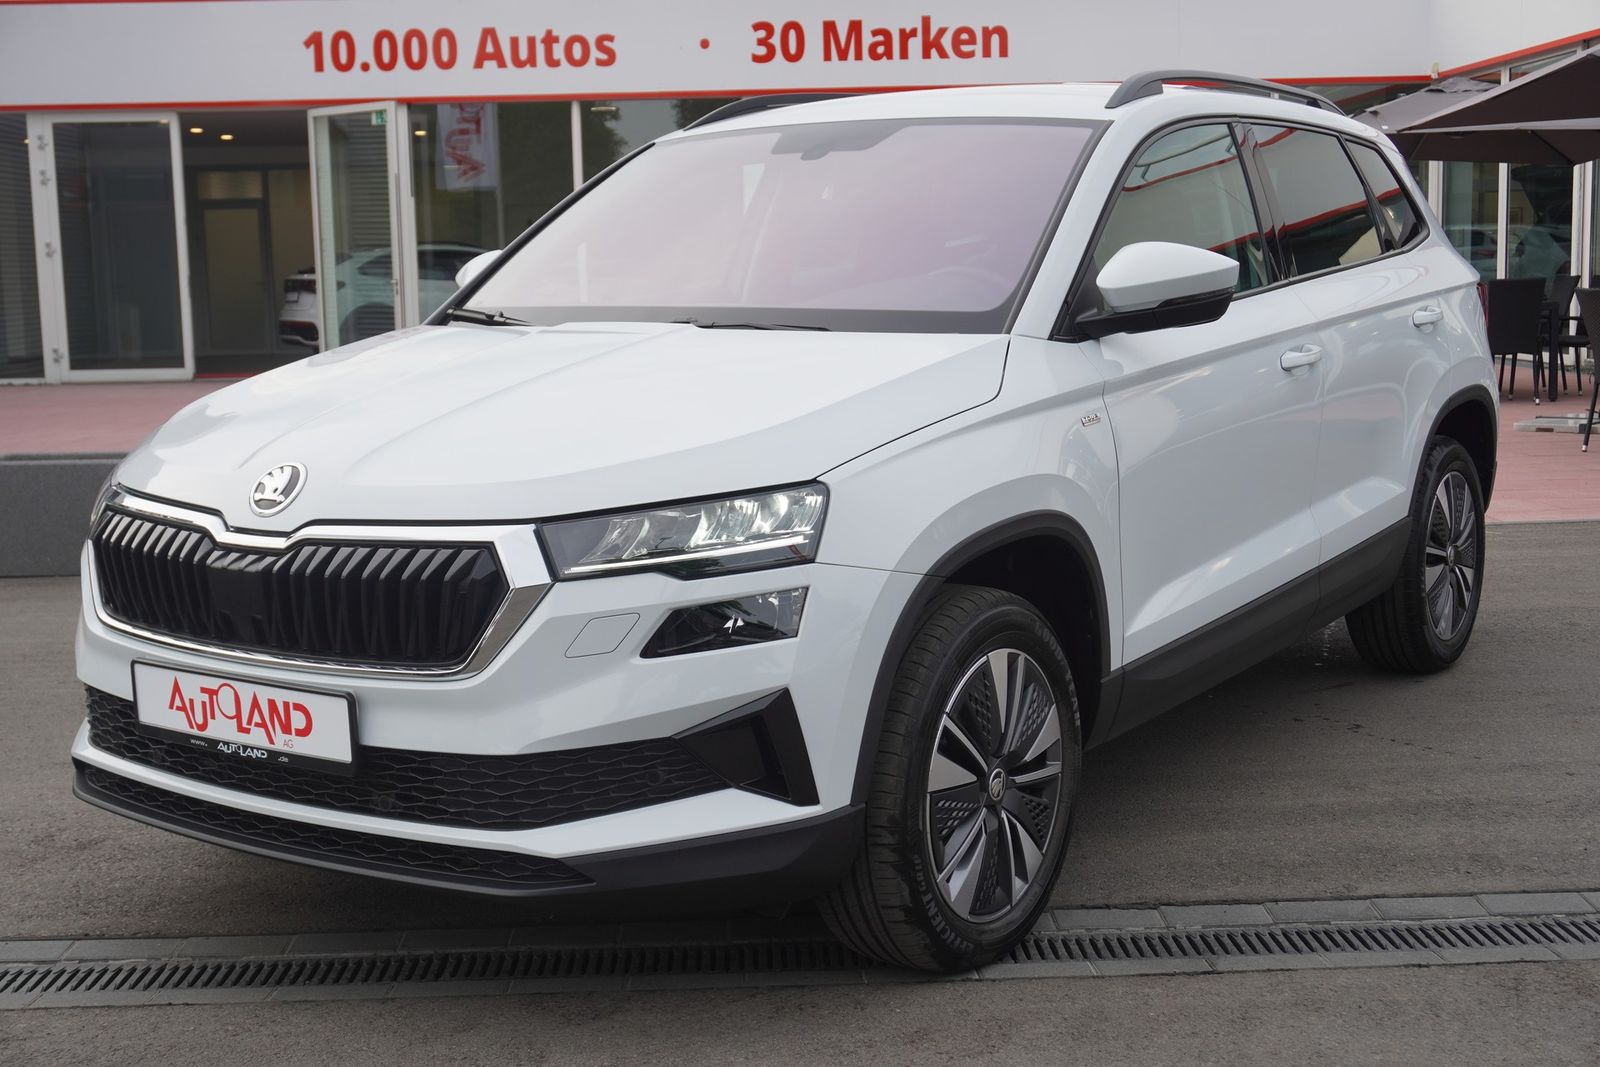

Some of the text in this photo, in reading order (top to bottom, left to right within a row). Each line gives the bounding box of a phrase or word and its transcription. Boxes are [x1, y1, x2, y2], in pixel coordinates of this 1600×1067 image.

[303, 27, 617, 72] 10.000 Autos
[751, 15, 1009, 63] 30 Marken
[168, 676, 313, 746] AUTOLAND
[283, 739, 294, 749] AG
